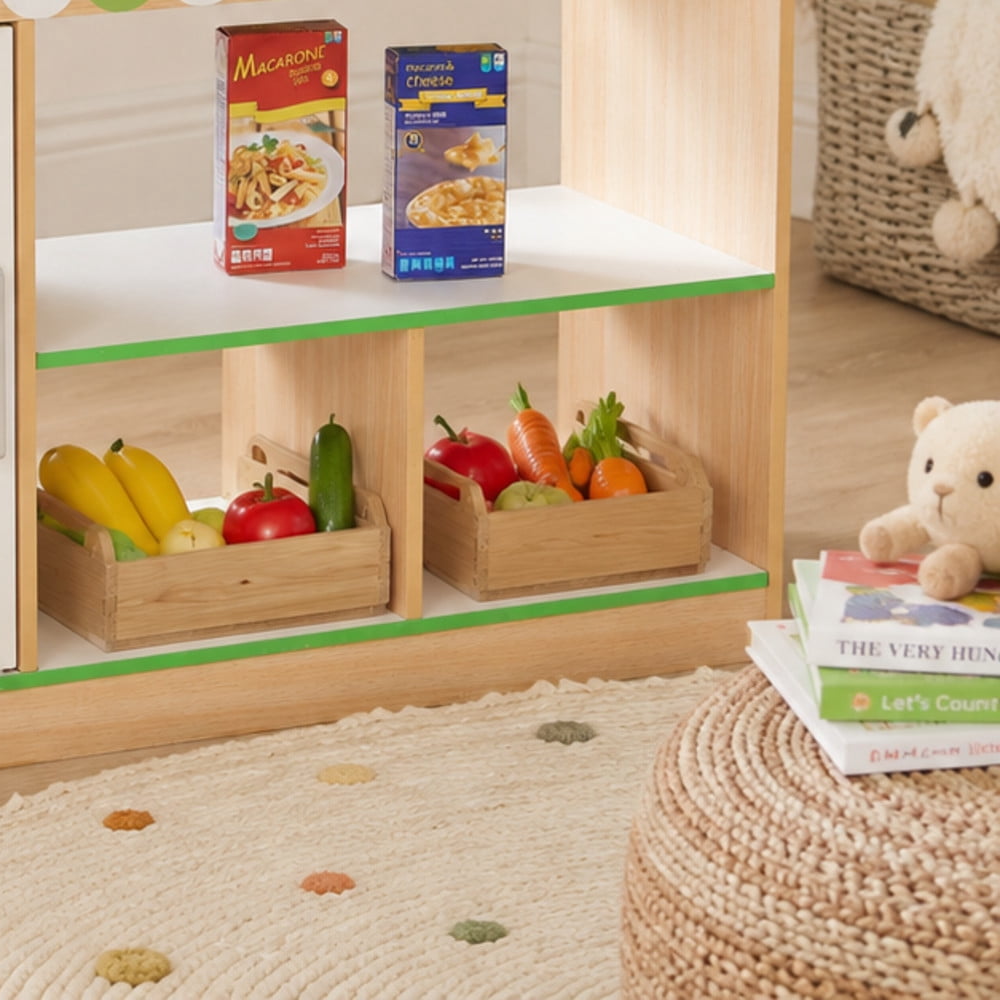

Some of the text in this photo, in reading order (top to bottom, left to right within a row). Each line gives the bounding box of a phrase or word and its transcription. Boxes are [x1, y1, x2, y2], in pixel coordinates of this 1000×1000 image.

[837, 639, 1000, 662] THE VERY HUN
[881, 694, 999, 712] Let's Count
